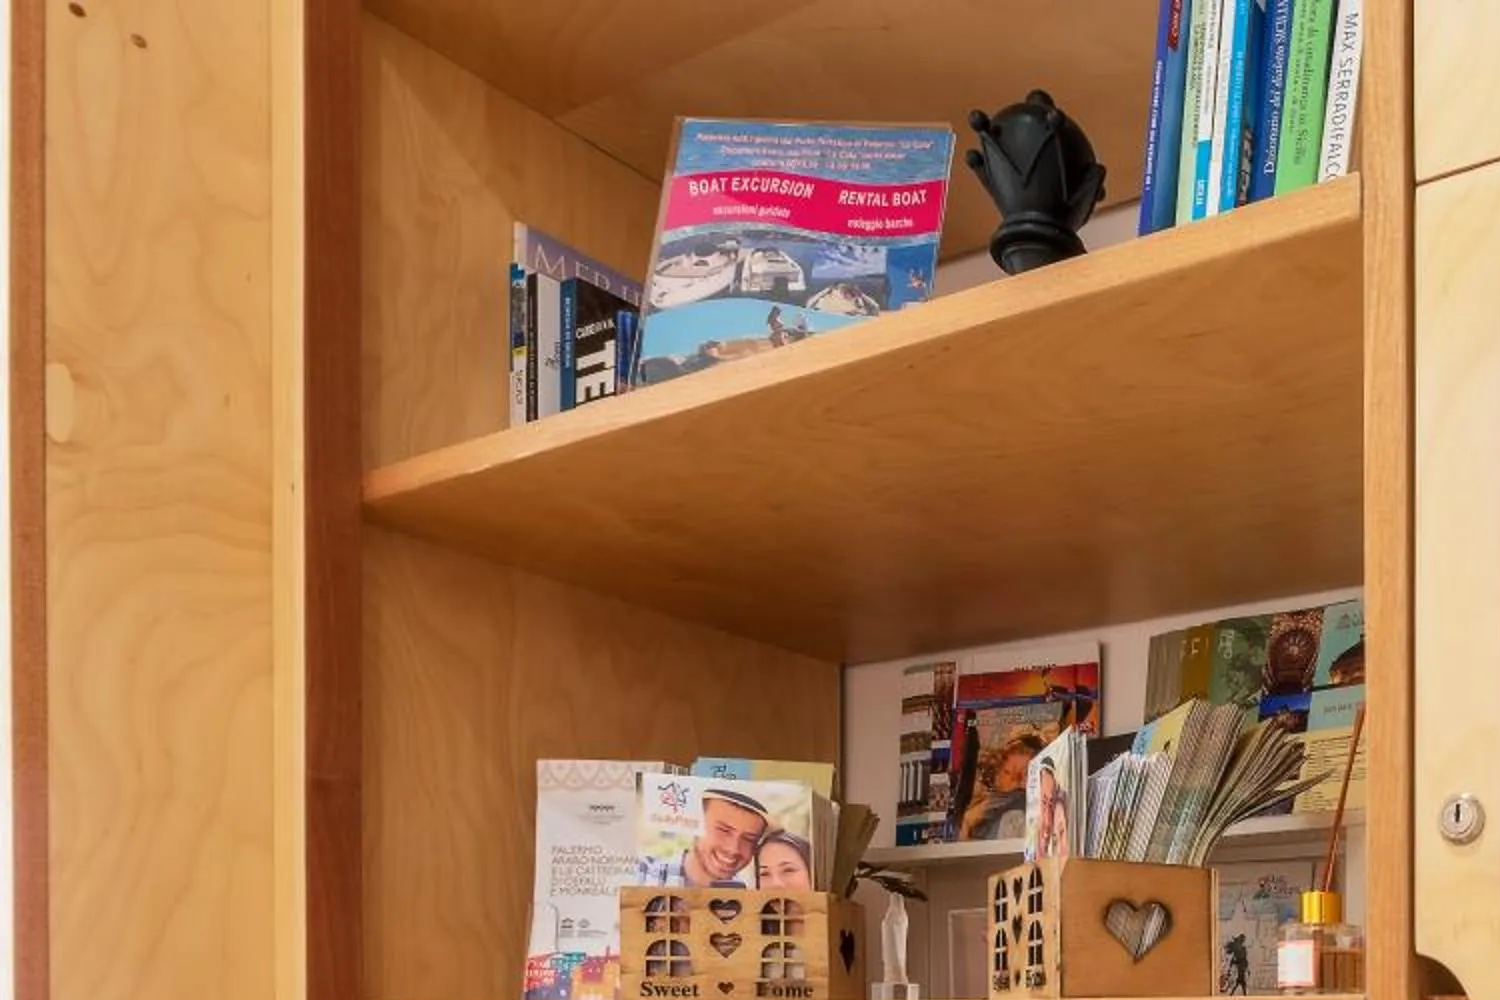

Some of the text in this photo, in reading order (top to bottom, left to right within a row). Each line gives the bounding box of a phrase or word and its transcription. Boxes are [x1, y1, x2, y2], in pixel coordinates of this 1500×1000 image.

[1342, 12, 1359, 52] MAX
[689, 177, 814, 198] BOAT EXCURSION
[837, 189, 928, 207] RENTAL BOAT
[641, 980, 701, 998] Sweet
